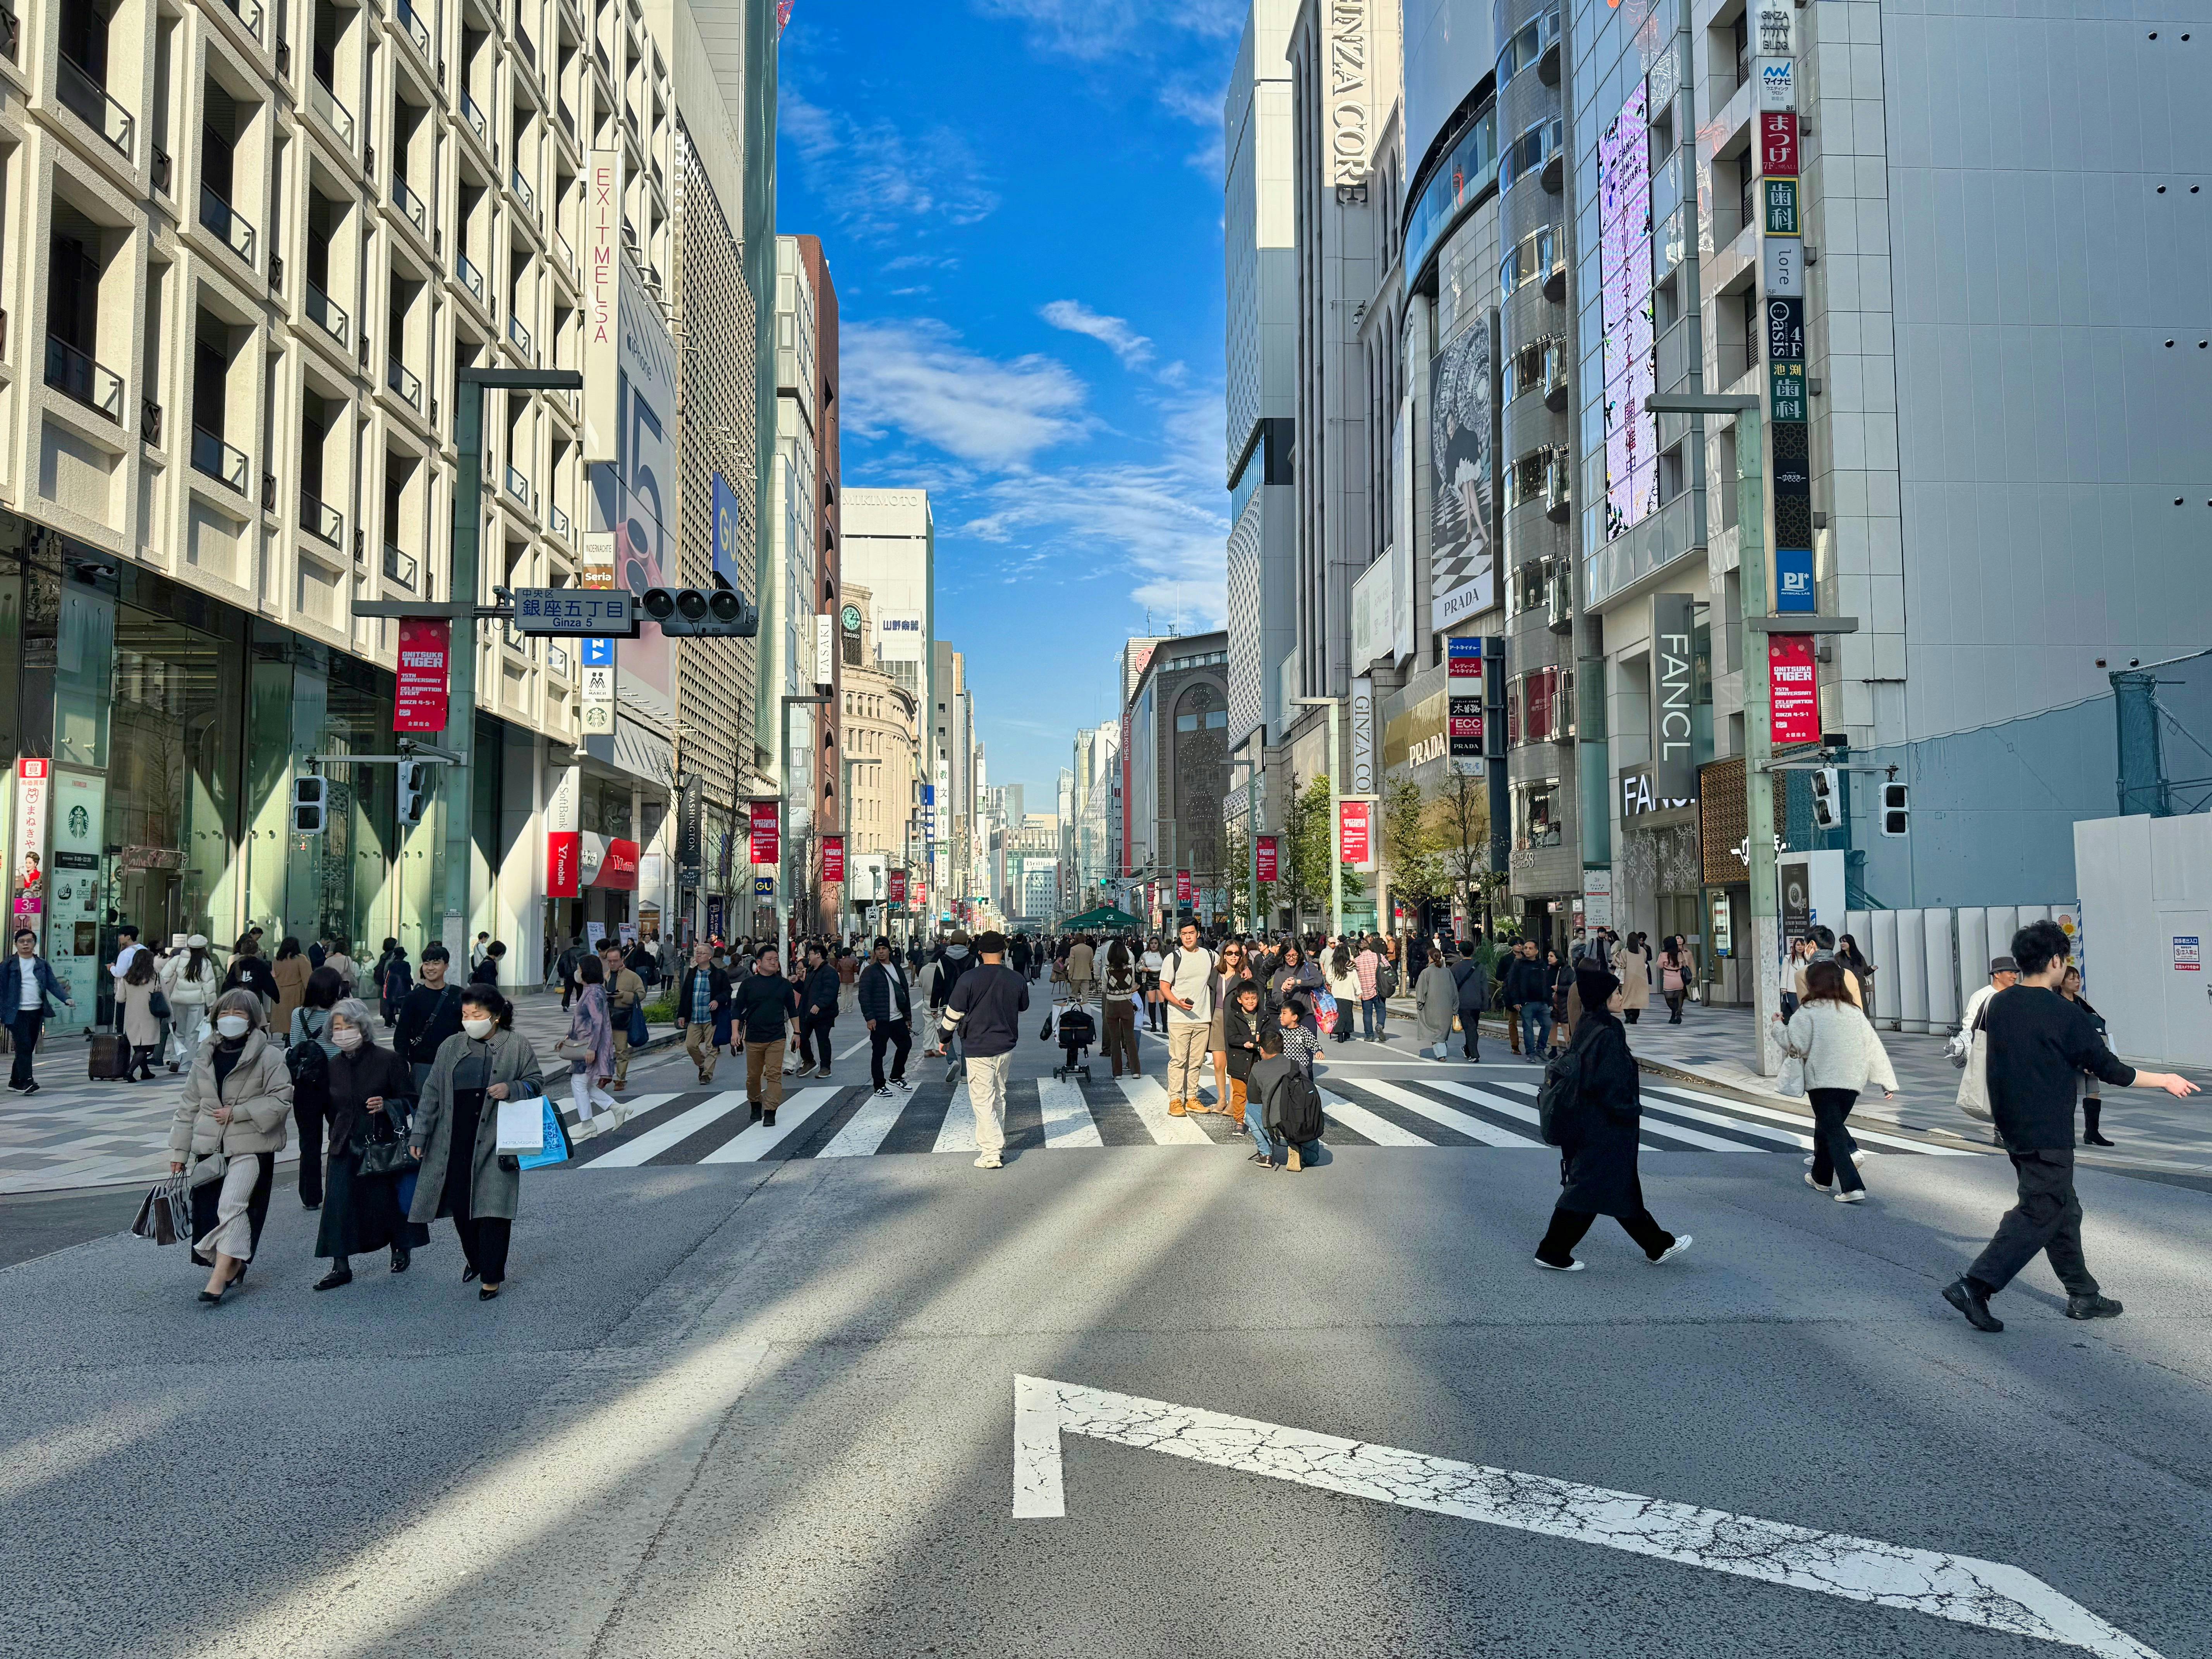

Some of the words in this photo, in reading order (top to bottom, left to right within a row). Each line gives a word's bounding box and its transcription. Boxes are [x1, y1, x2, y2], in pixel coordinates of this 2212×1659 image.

[1761, 11, 1789, 20] GINZA
[1333, 0, 1365, 96] INZA
[1763, 40, 1789, 50] BLDG.
[1333, 100, 1368, 204] CORE
[1619, 132, 1635, 162] FANCL
[1768, 115, 1791, 163] まつげ
[1619, 153, 1636, 180] GINZA
[1620, 161, 1642, 195] SQUARE
[1770, 183, 1793, 230] 歯科
[594, 168, 610, 343] EXITMELSA
[1779, 249, 1791, 285] lore
[1770, 301, 1789, 356] Oasis
[1790, 326, 1803, 357] 4F
[632, 340, 652, 381] iPhone
[1776, 378, 1802, 418] 歯科
[720, 507, 736, 562] GU
[522, 589, 554, 598] 中央区
[585, 572, 611, 581] Seria
[522, 599, 622, 617] 銀座五丁目
[1444, 588, 1479, 617] PRADA
[553, 618, 581, 627] Ginza
[586, 618, 592, 627] 5
[402, 657, 443, 668] TIGER
[821, 624, 829, 676] TASAKI
[1774, 671, 1812, 681] TIGER
[1661, 634, 1691, 761] FANCL
[1355, 696, 1370, 757] GINZA
[1456, 719, 1481, 728] ECC
[1409, 732, 1447, 769] PRADA
[28, 763, 38, 774] 買
[559, 787, 569, 828] SoftBank
[25, 805, 36, 848] まねきや
[558, 843, 568, 886] Y!mobile
[756, 882, 772, 891] GU
[21, 900, 34, 910] 3F
